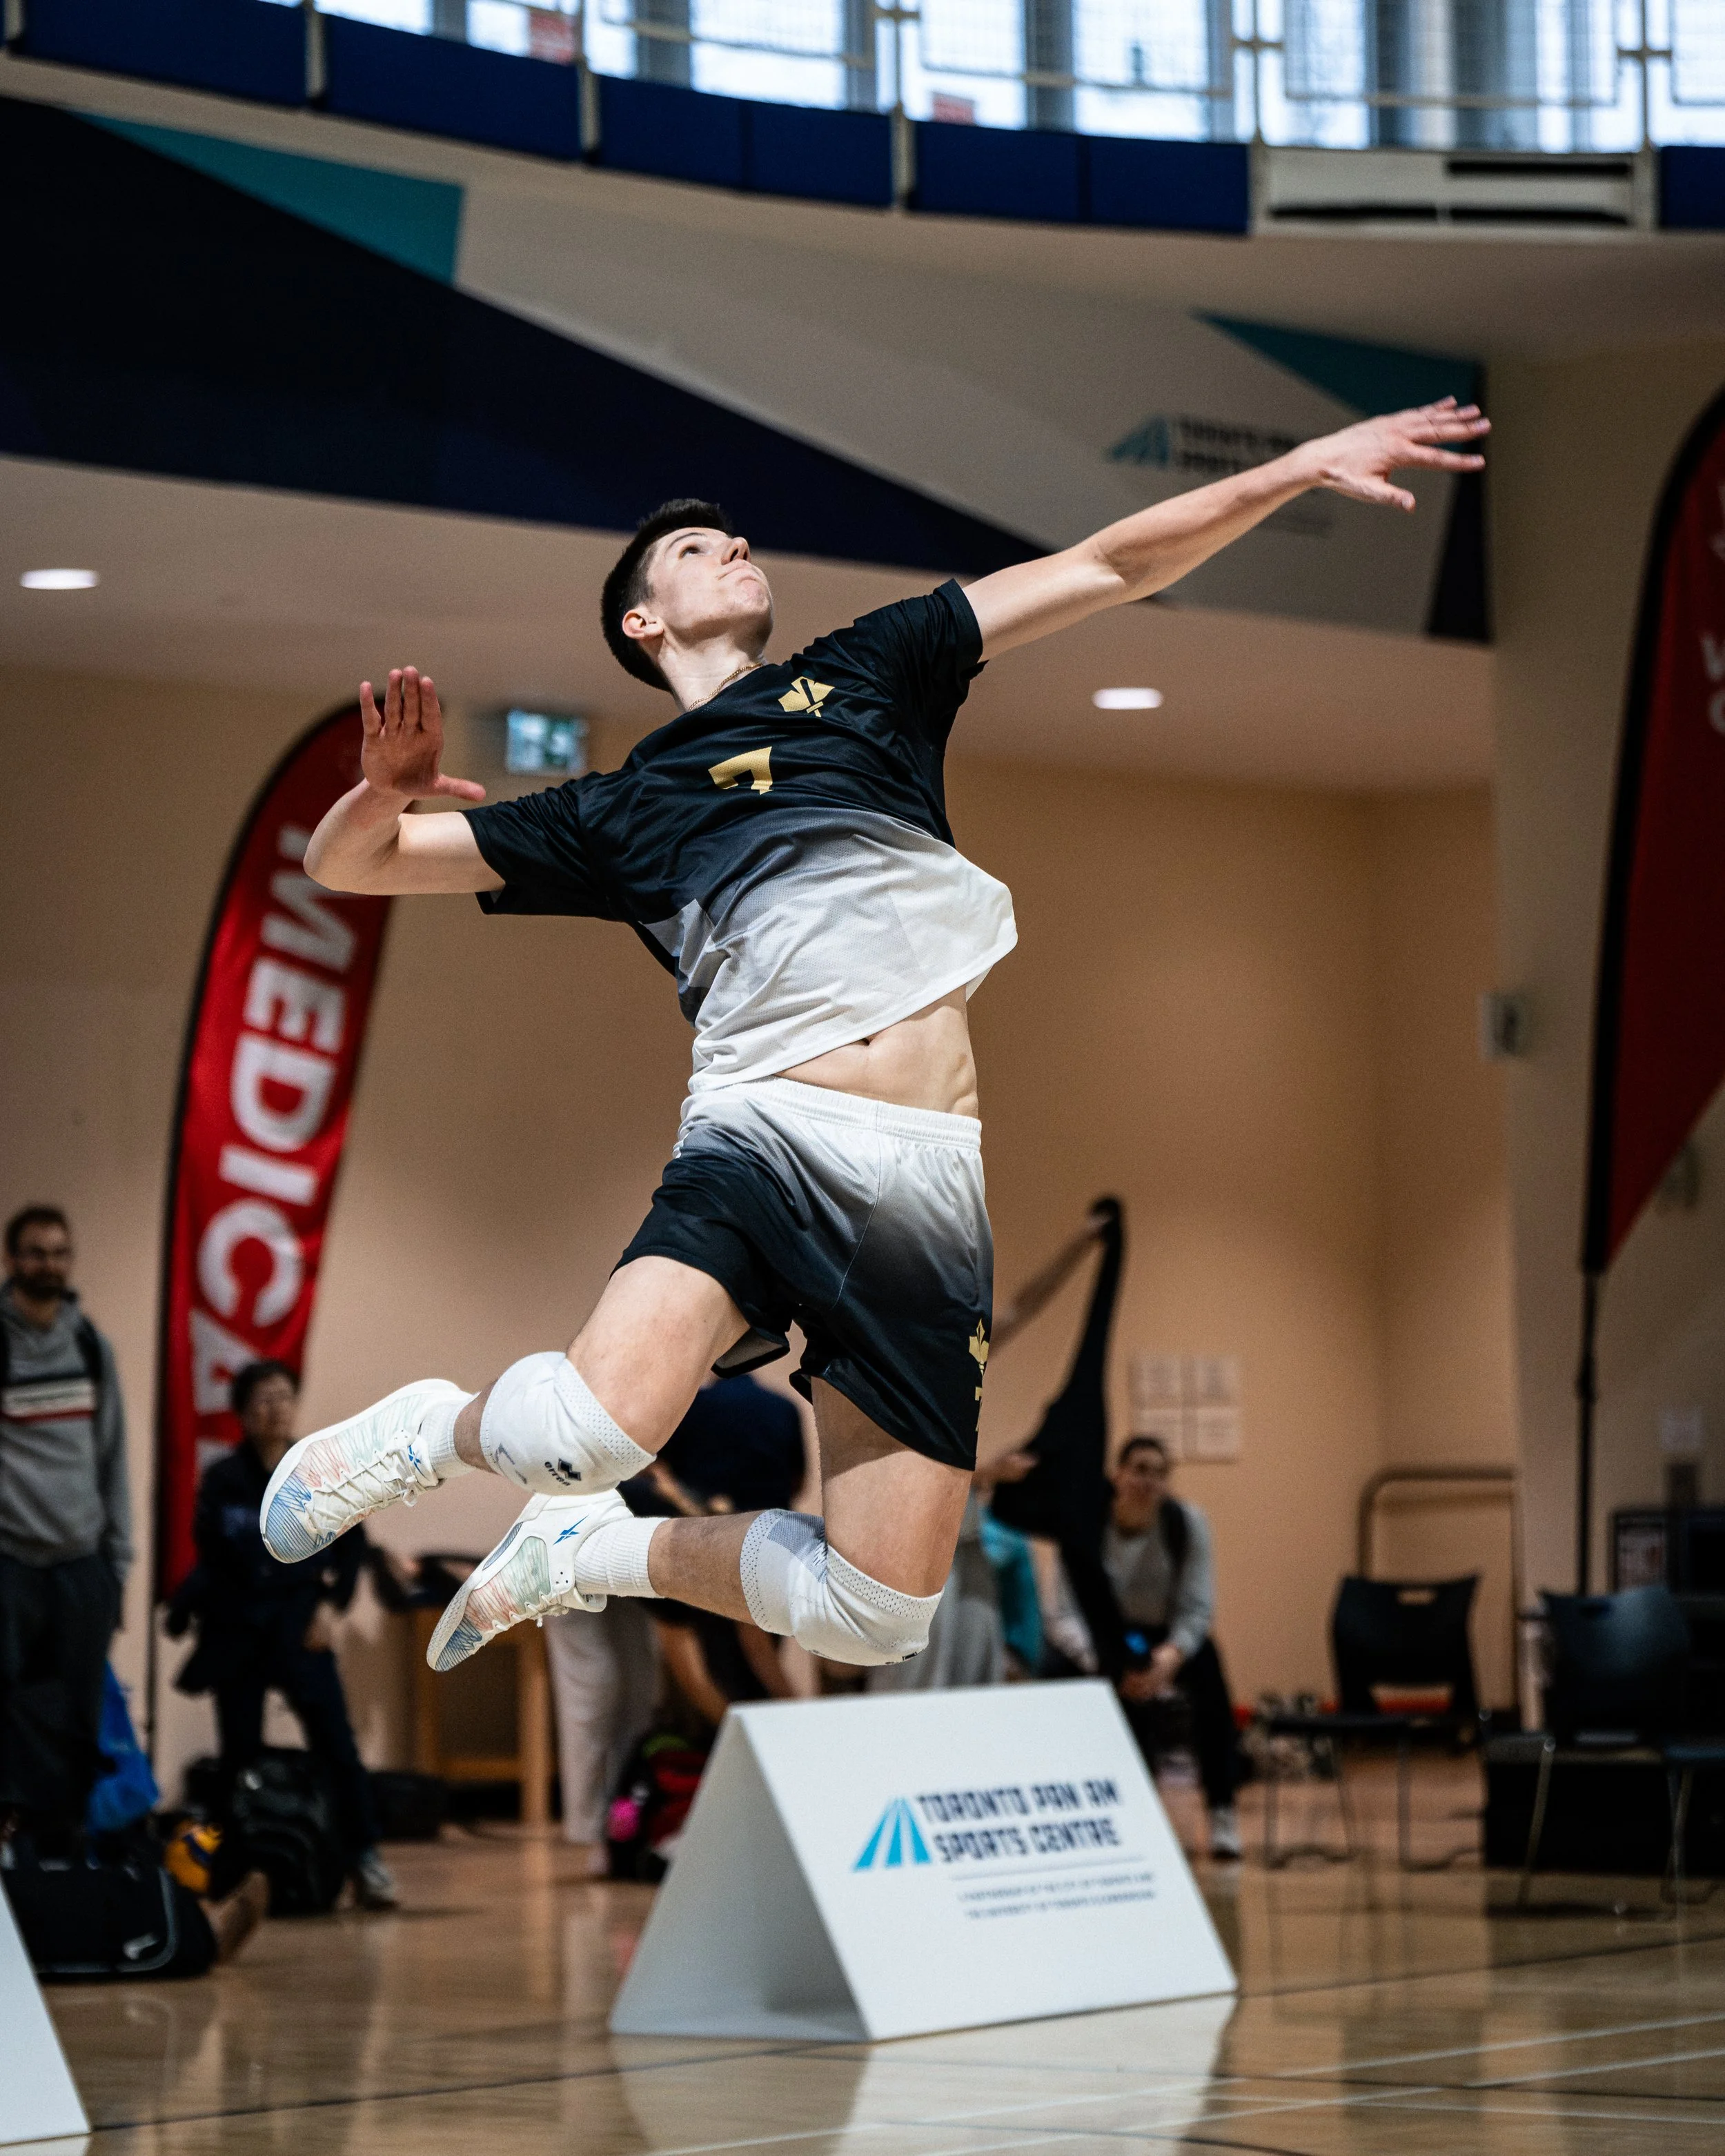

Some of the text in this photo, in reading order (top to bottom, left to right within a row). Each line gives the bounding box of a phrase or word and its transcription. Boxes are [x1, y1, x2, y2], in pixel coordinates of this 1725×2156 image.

[188, 824, 359, 1494] MEDICA
[917, 1778, 1119, 1823] TORONTO PAN AM
[933, 1817, 1121, 1863] SPORTS CENTRE
